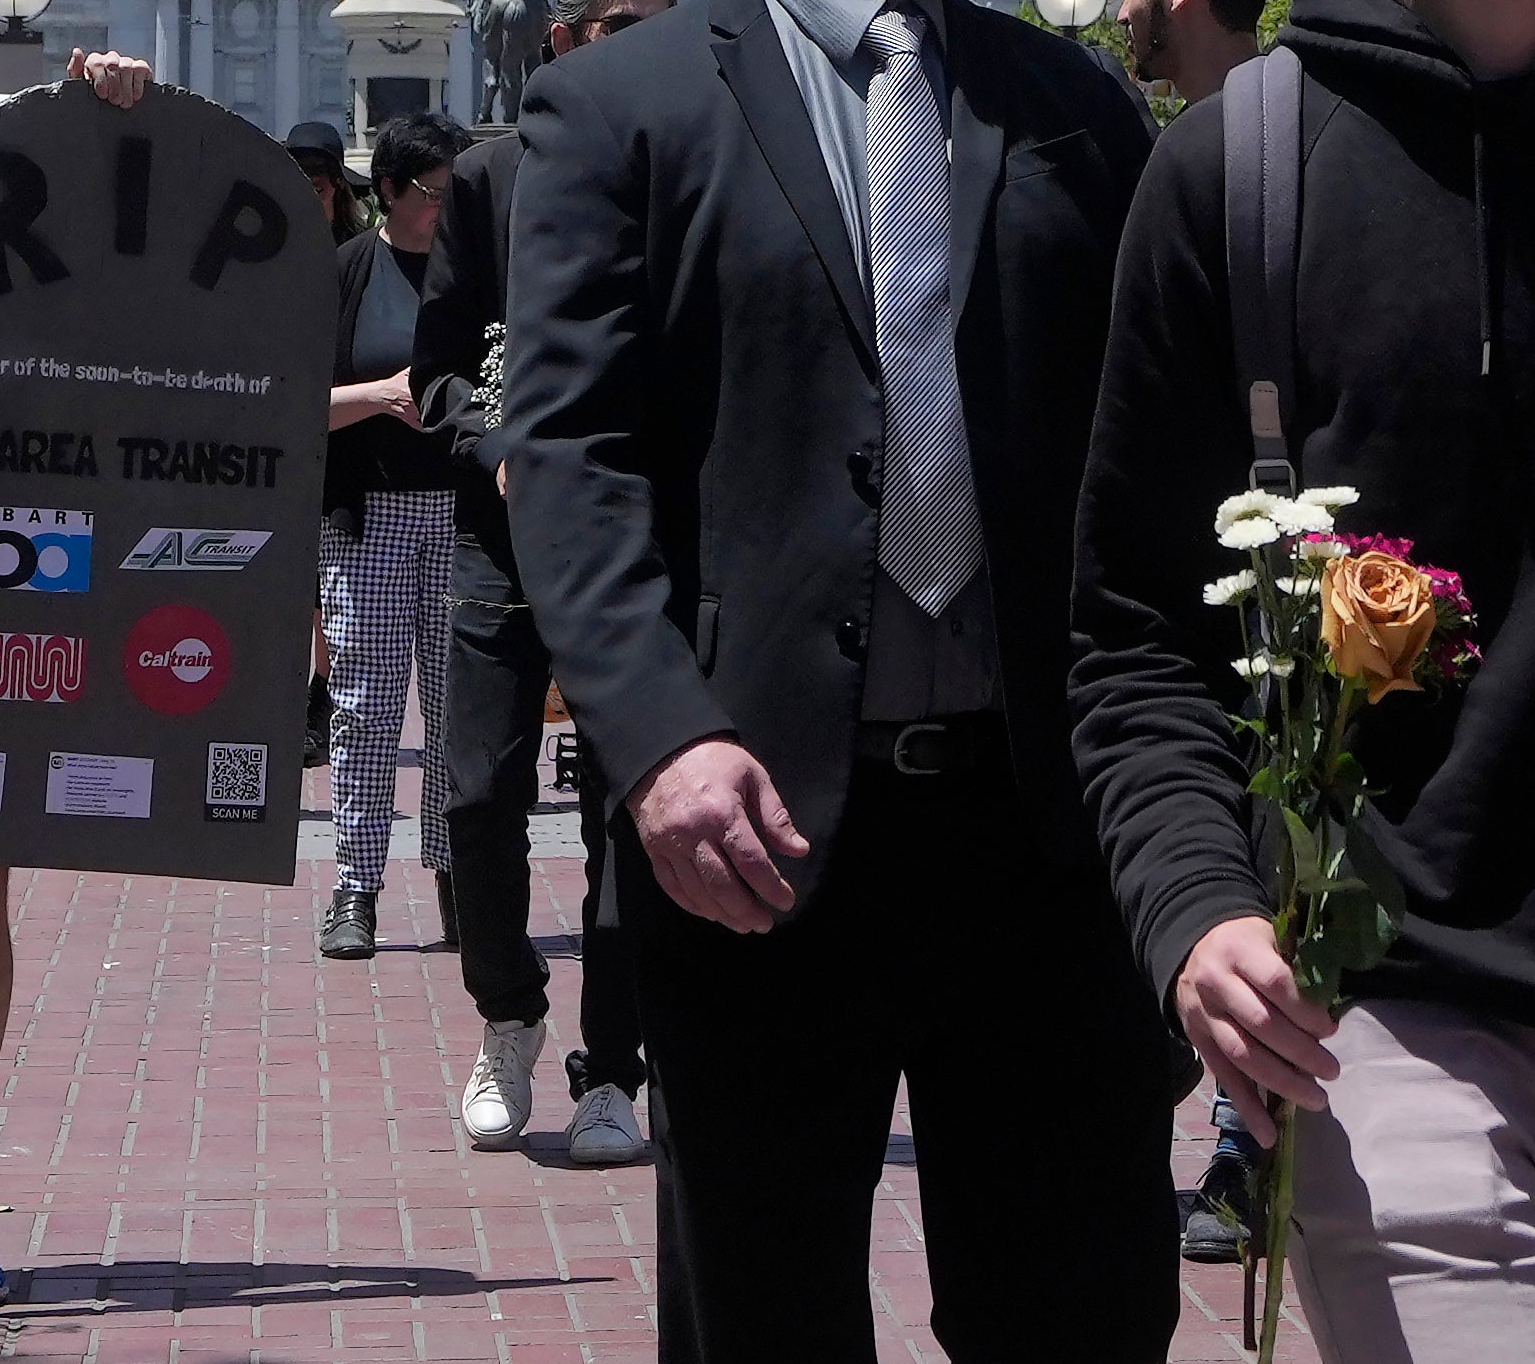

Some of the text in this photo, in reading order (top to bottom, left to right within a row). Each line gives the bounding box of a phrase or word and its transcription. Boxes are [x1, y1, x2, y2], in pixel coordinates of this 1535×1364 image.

[14, 357, 36, 377] of
[39, 358, 70, 378] the
[117, 437, 286, 488] TRANSIT
[2, 508, 94, 527] BART
[203, 544, 256, 555] TRANSIT
[138, 650, 212, 669] Caltrain
[212, 807, 258, 820] SCAN ME
